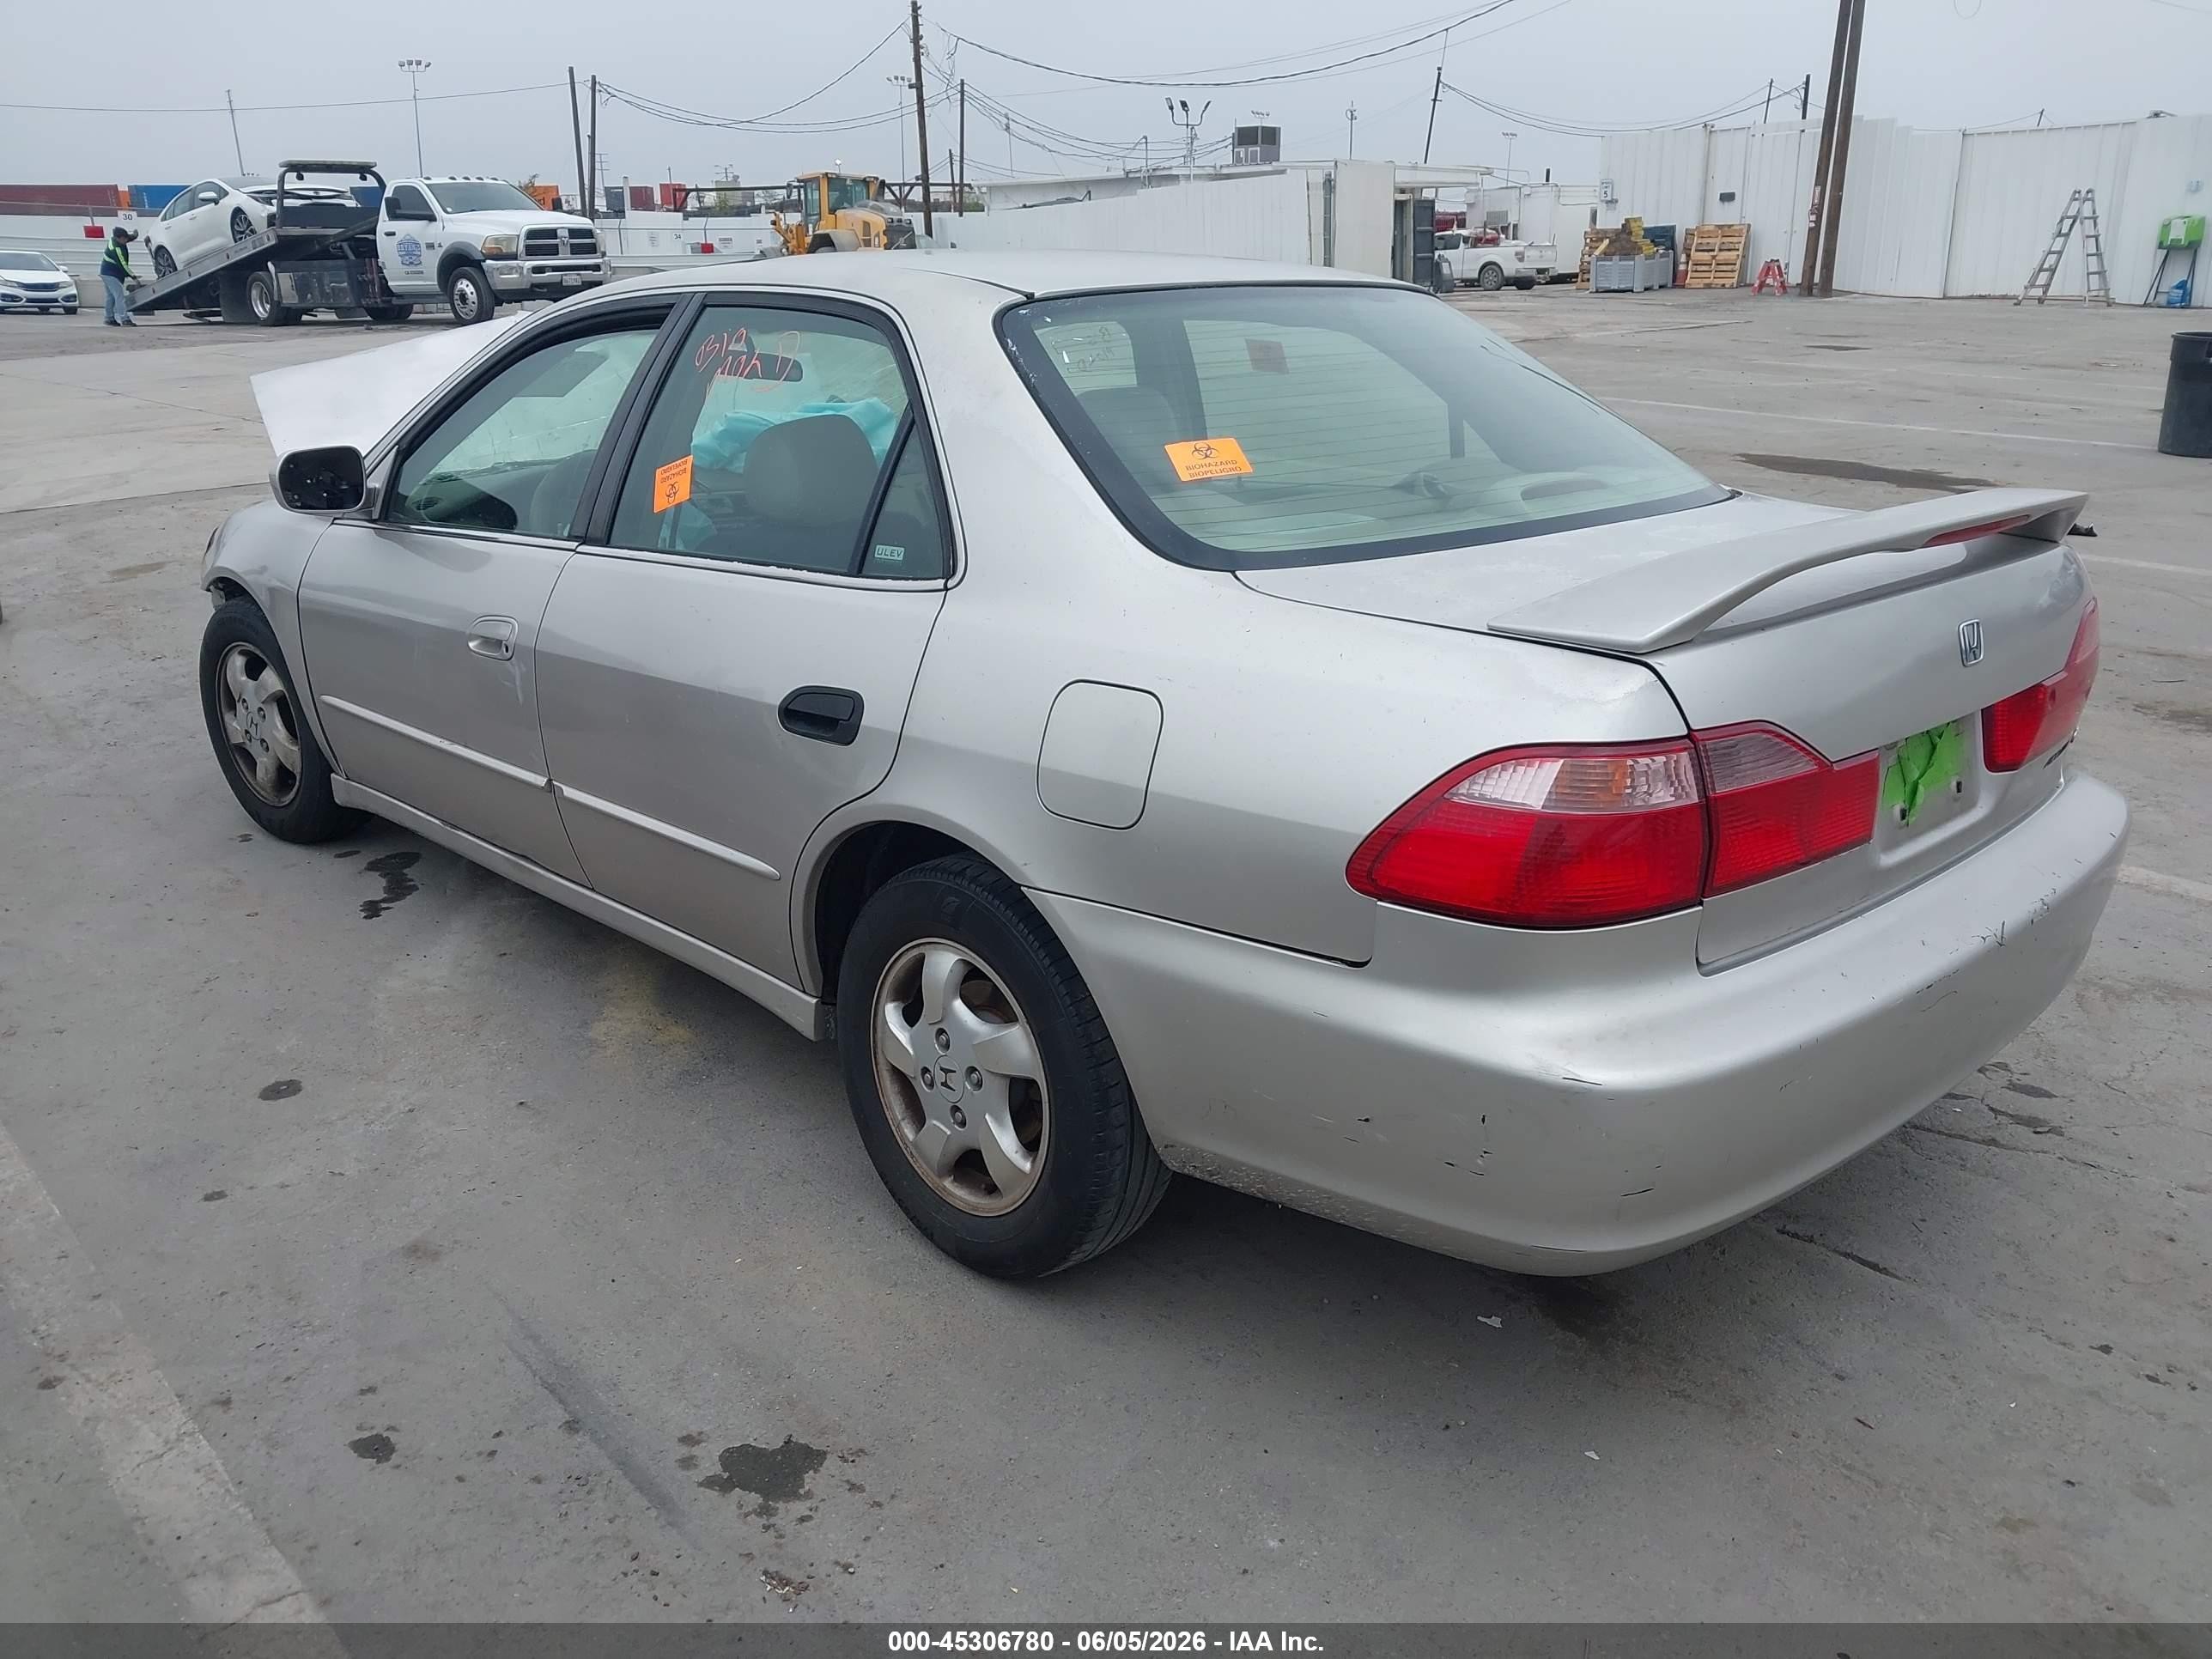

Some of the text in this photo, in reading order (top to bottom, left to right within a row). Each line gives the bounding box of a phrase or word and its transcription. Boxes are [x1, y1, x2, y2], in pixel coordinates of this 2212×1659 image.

[1185, 459, 1237, 471] BIOHAZARD
[1188, 466, 1242, 478] BIOPELIGRO
[877, 547, 903, 557] ULEV
